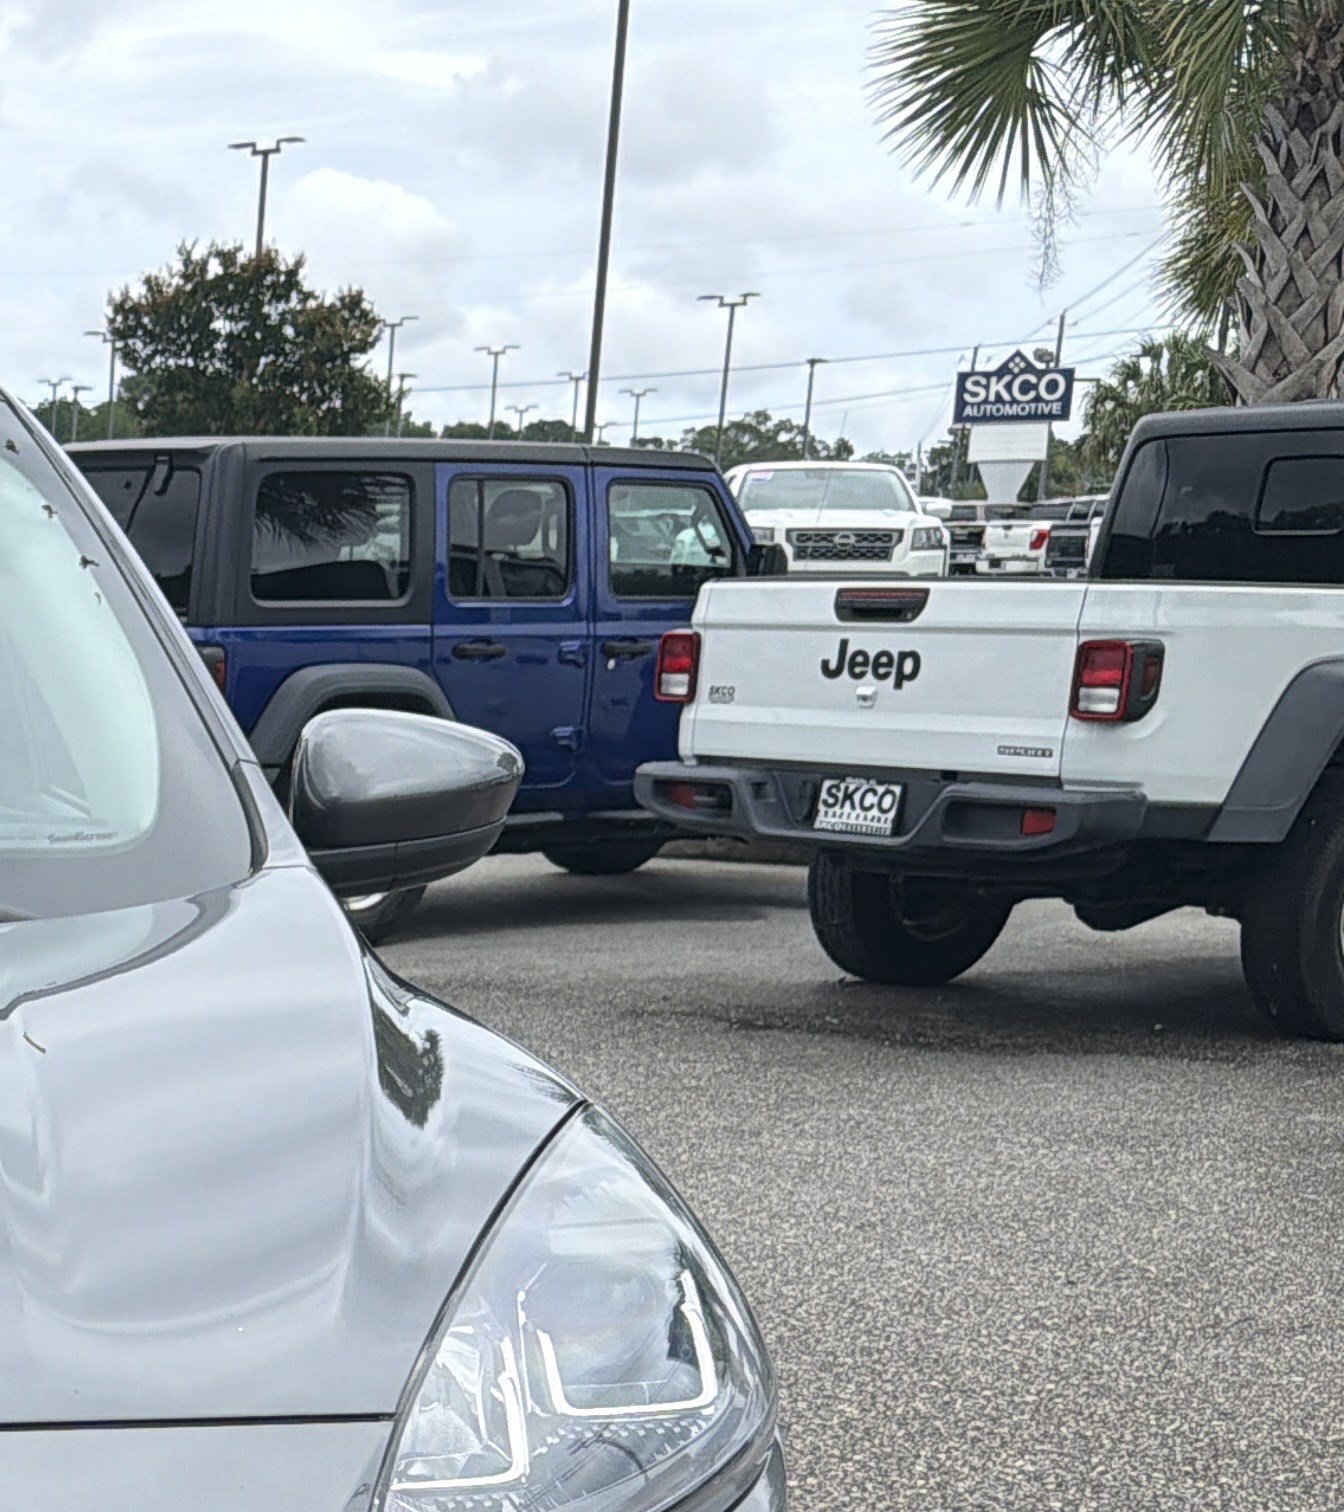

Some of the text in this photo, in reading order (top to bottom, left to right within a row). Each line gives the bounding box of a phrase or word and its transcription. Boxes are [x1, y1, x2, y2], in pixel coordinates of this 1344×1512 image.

[963, 373, 1066, 403] SKCO
[963, 402, 1063, 417] AUTOMOTIVE
[821, 638, 921, 690] Jeep
[822, 783, 897, 815] SKCO
